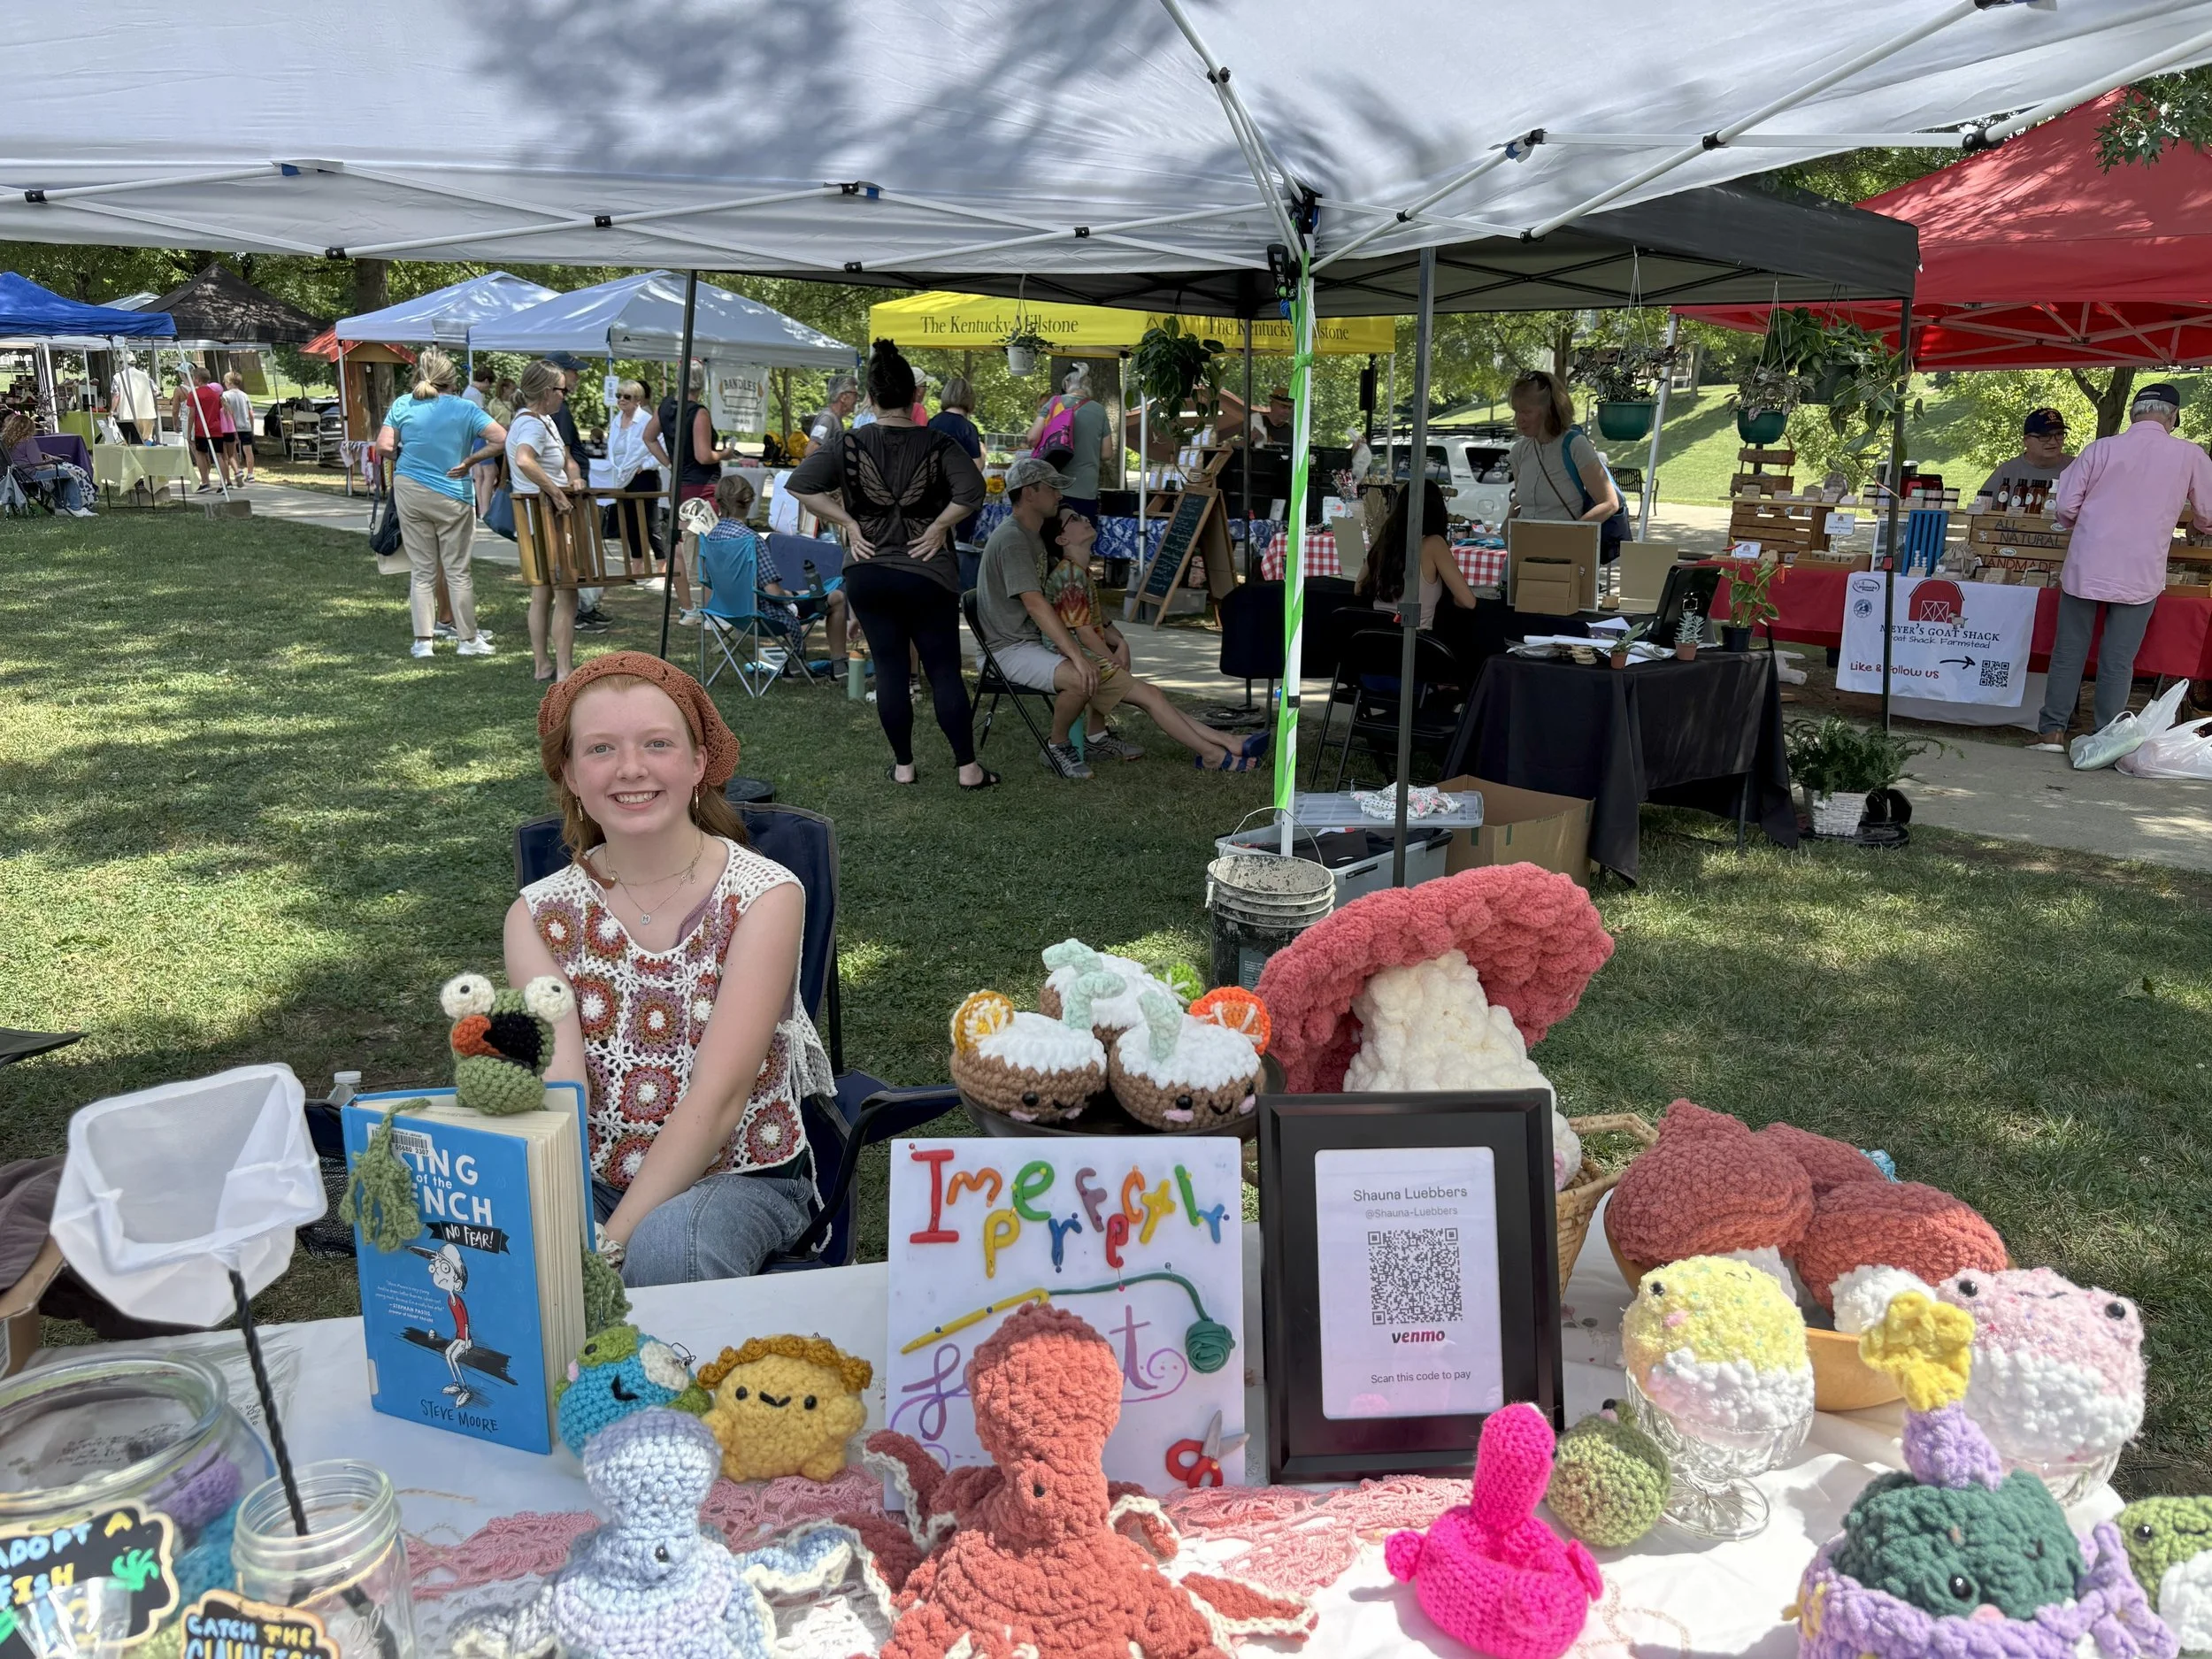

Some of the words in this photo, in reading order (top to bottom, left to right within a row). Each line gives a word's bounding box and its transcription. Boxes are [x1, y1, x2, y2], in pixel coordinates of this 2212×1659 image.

[920, 316, 946, 334] The
[950, 314, 1011, 334] Kentucky
[1209, 317, 1233, 335] The
[1238, 319, 1294, 342] Kntucky
[1994, 518, 2016, 531] ALL
[2000, 532, 2062, 547] NATURAL
[1991, 545, 1998, 555] &
[1928, 627, 1960, 638] GOAT
[1962, 630, 2001, 641] SHACK
[1909, 635, 1937, 644] Shack
[1940, 637, 1991, 649] Farmstead
[1850, 660, 1872, 672] Like
[1876, 664, 1882, 672] &
[1925, 670, 1939, 680] us
[416, 1174, 428, 1185] of
[433, 1176, 453, 1189] the
[1353, 1189, 1402, 1202] Shauna
[1405, 1187, 1468, 1200] Luebbers
[411, 1182, 493, 1226] NCH
[1365, 1206, 1458, 1219] @Shauna-Luebbers
[445, 1224, 460, 1239] NO
[464, 1226, 494, 1249] FEAR!
[1392, 1331, 1446, 1343] venmo
[1371, 1374, 1394, 1384] Scan
[1396, 1372, 1414, 1382] this
[1416, 1371, 1440, 1381] code
[1442, 1371, 1452, 1380] to
[1454, 1371, 1471, 1381] pay
[420, 1399, 454, 1420] STEVE
[458, 1411, 498, 1432] MOORE
[104, 1511, 133, 1539] A
[187, 1615, 257, 1642] CATCH
[263, 1623, 313, 1649] THE
